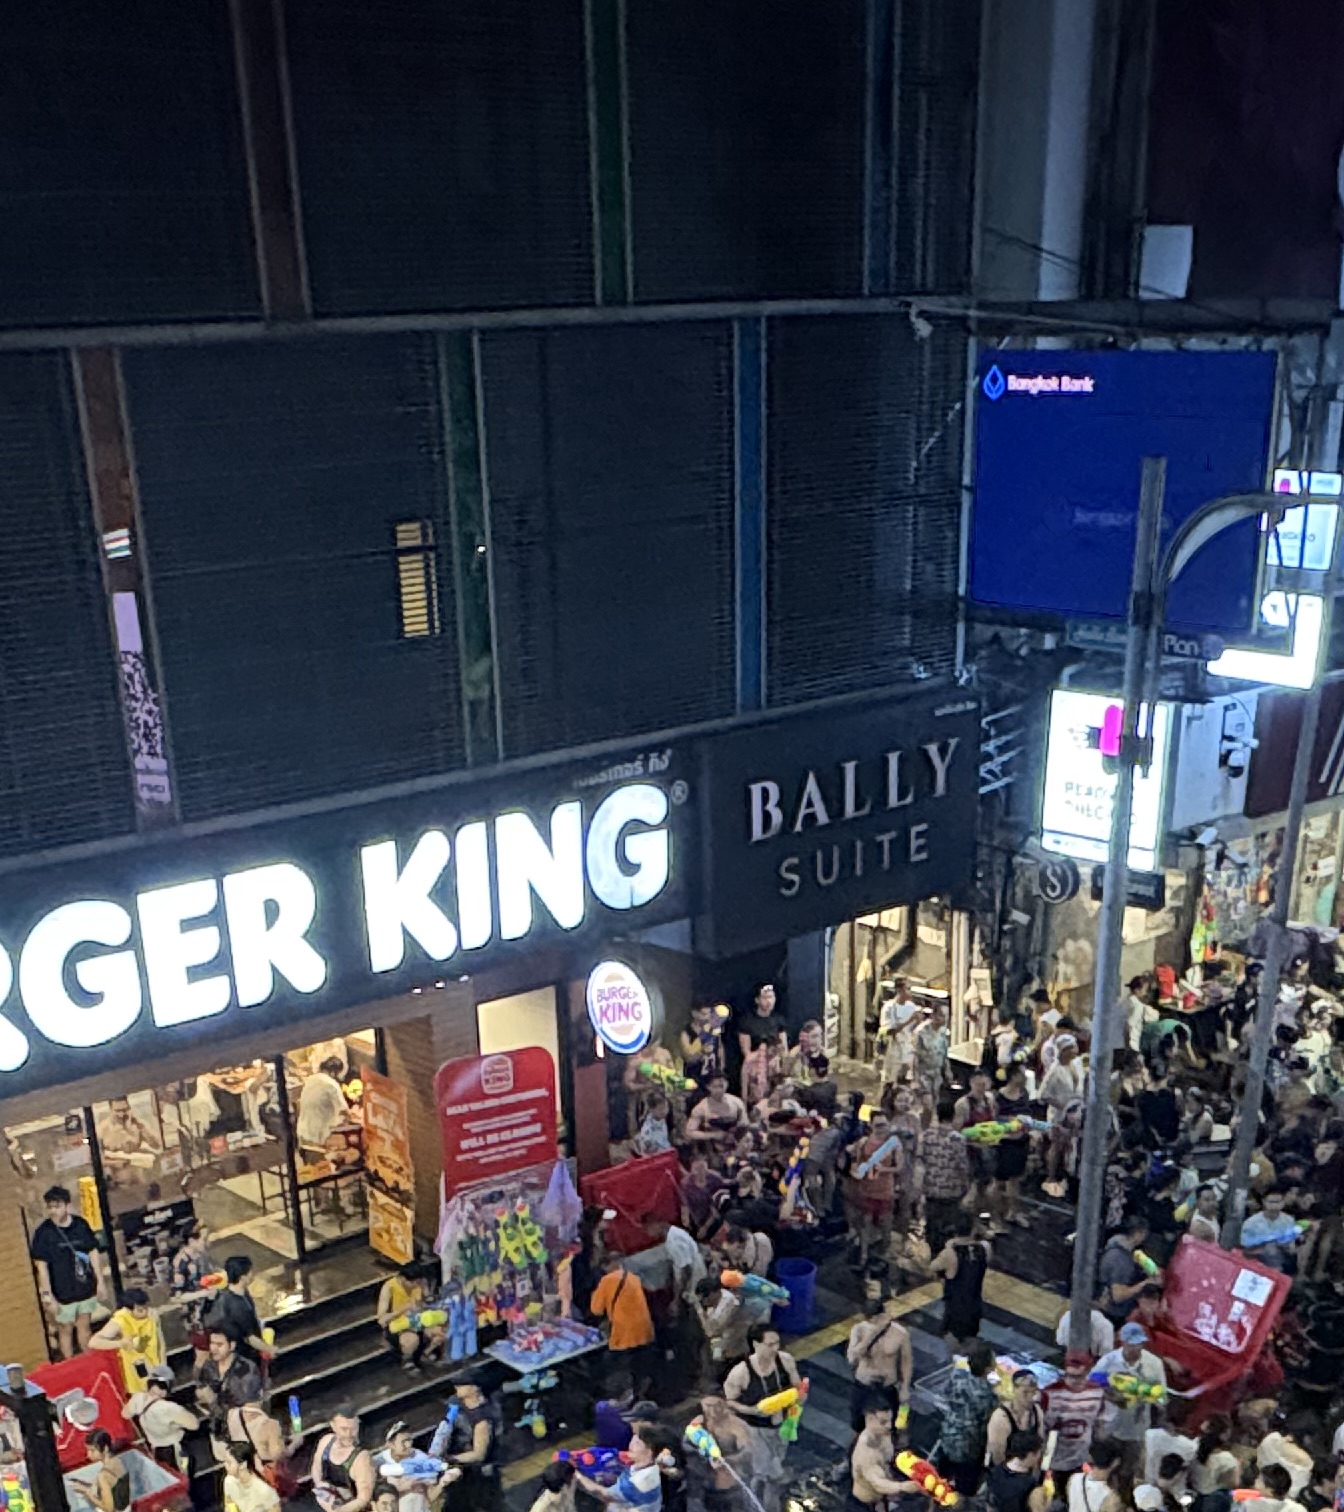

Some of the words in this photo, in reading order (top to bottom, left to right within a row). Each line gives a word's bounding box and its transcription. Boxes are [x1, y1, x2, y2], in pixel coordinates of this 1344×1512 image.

[1007, 375, 1059, 396] Bangkok
[1060, 376, 1094, 392] Bank
[748, 737, 960, 844] BALLY
[360, 785, 670, 974] KING
[779, 823, 929, 897] SUITE
[599, 1001, 643, 1024] KING
